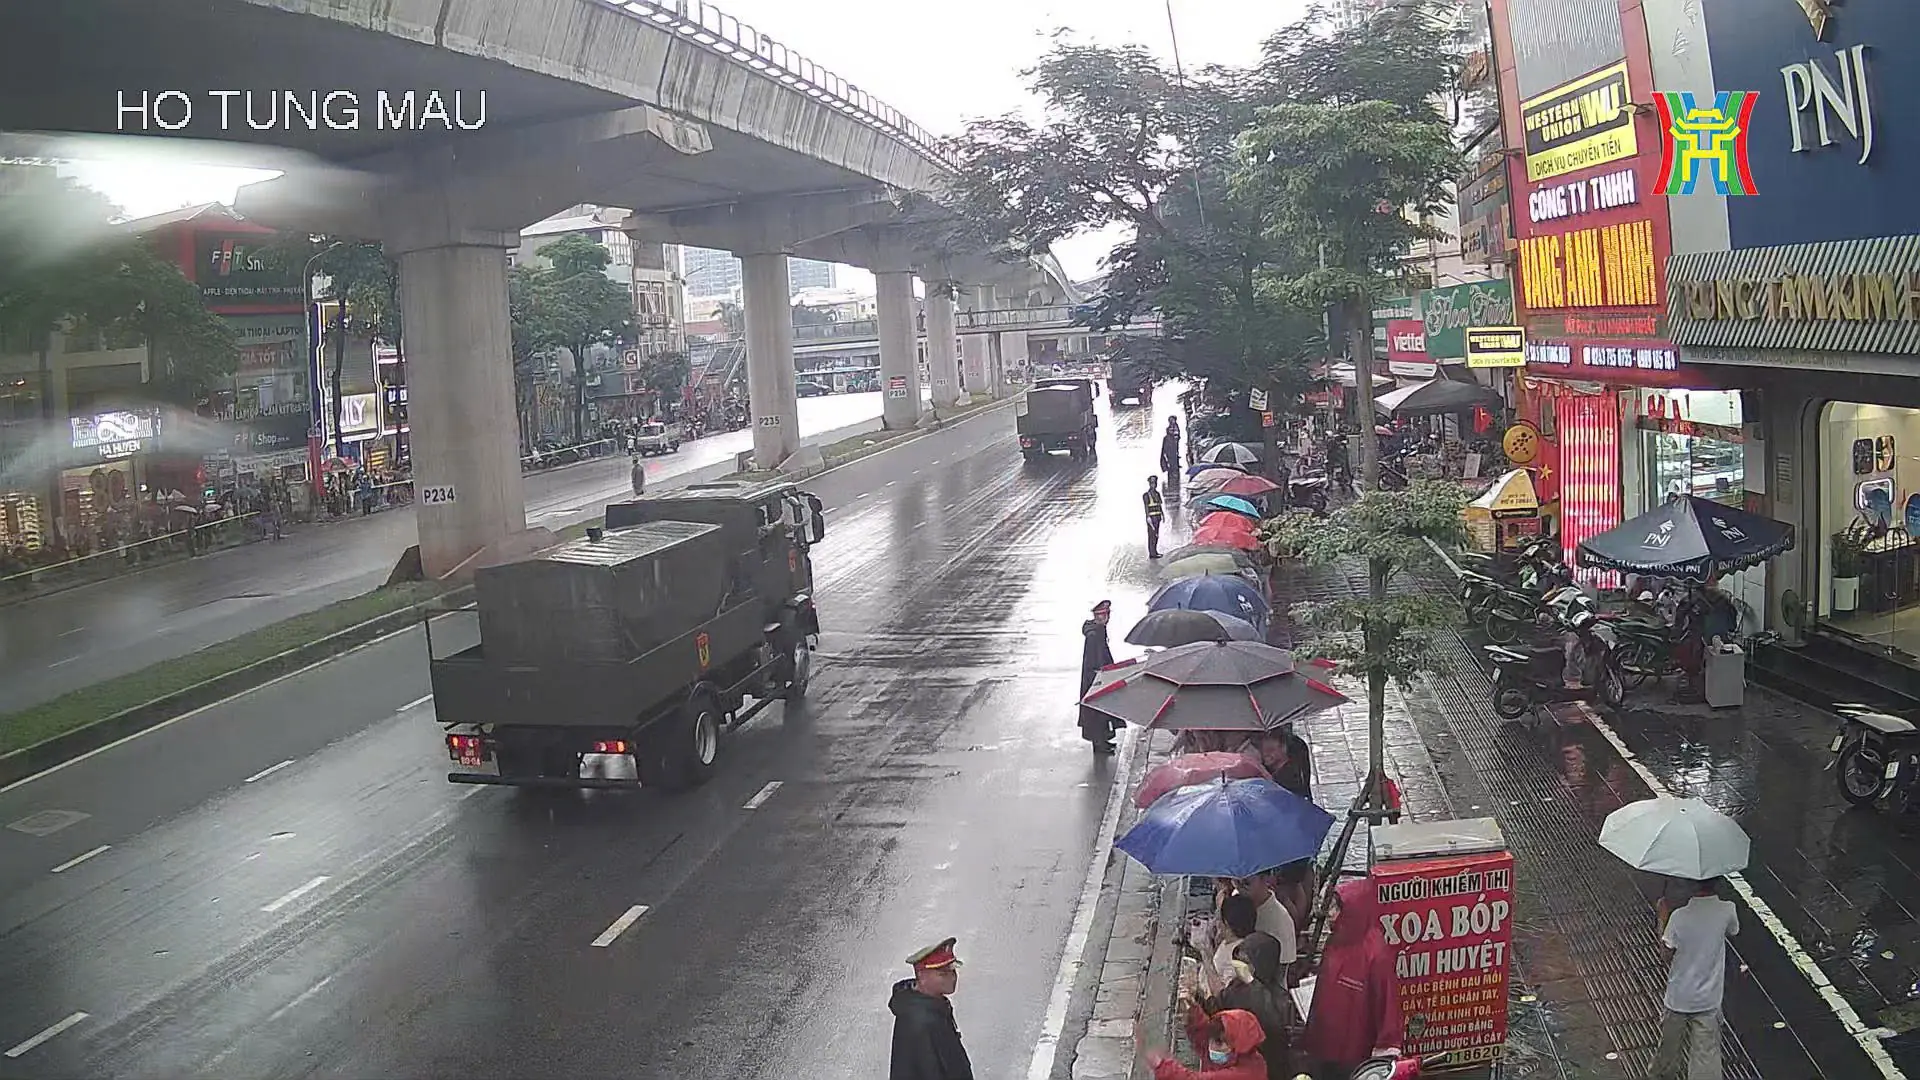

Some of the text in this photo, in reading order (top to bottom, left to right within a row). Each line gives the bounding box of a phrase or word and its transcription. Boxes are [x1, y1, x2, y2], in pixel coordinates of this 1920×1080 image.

[1525, 97, 1580, 132] WESTERN
[1780, 44, 1872, 165] PNJ
[1541, 115, 1583, 143] UNION
[1528, 183, 1568, 223] CÔNG
[1568, 180, 1588, 214] TY
[1589, 169, 1637, 210] TNHH
[1564, 228, 1603, 308] ANH
[1601, 219, 1658, 306] MINH
[1828, 270, 1899, 321] KIM
[1393, 331, 1426, 352] viettel
[759, 416, 780, 425] P235
[424, 487, 455, 503] P234
[1643, 533, 1671, 547] PNJ
[1378, 868, 1510, 904] NGƯỜI KHIẾM THỊ
[1379, 893, 1509, 945] XOA BÓP
[1436, 939, 1506, 973] HUYỆT
